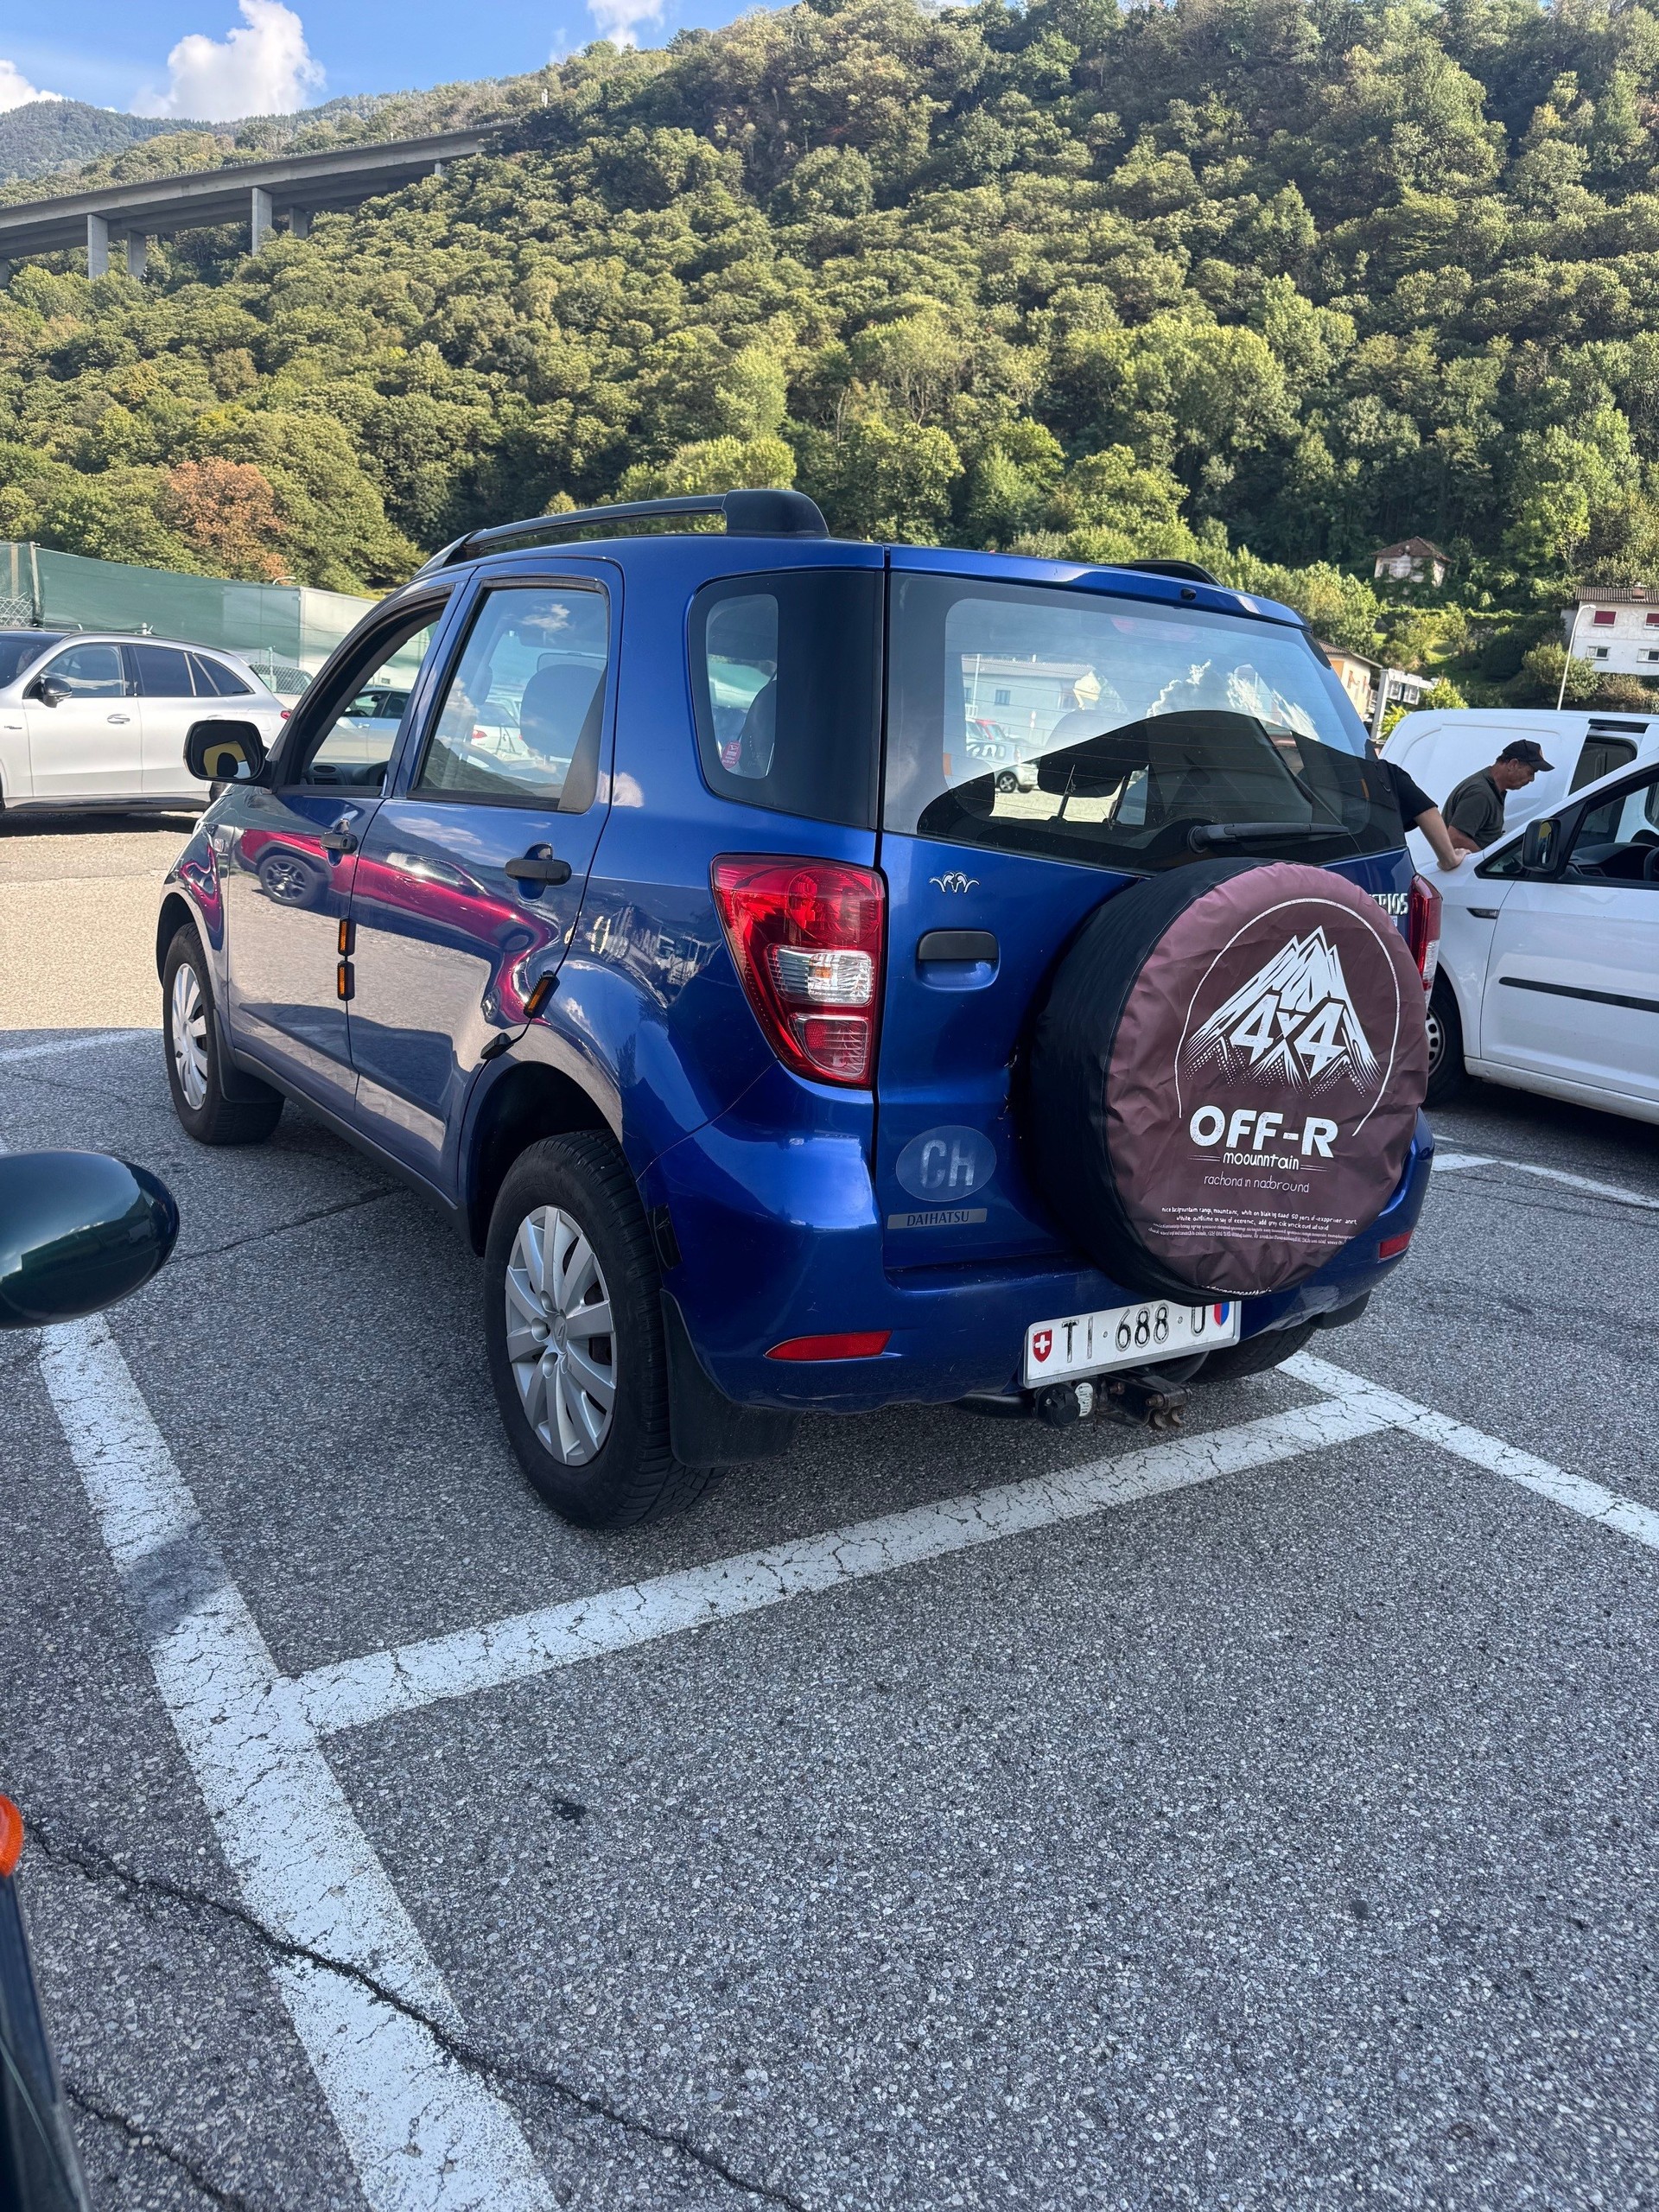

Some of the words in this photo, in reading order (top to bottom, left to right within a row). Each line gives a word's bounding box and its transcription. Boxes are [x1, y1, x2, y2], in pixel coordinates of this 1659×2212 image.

[1368, 893, 1408, 915] RIOS
[1189, 1105, 1338, 1158] OFF-R
[906, 1211, 969, 1226] DAIHATSU
[1061, 1316, 1093, 1363] TI
[1115, 1302, 1170, 1351] 688
